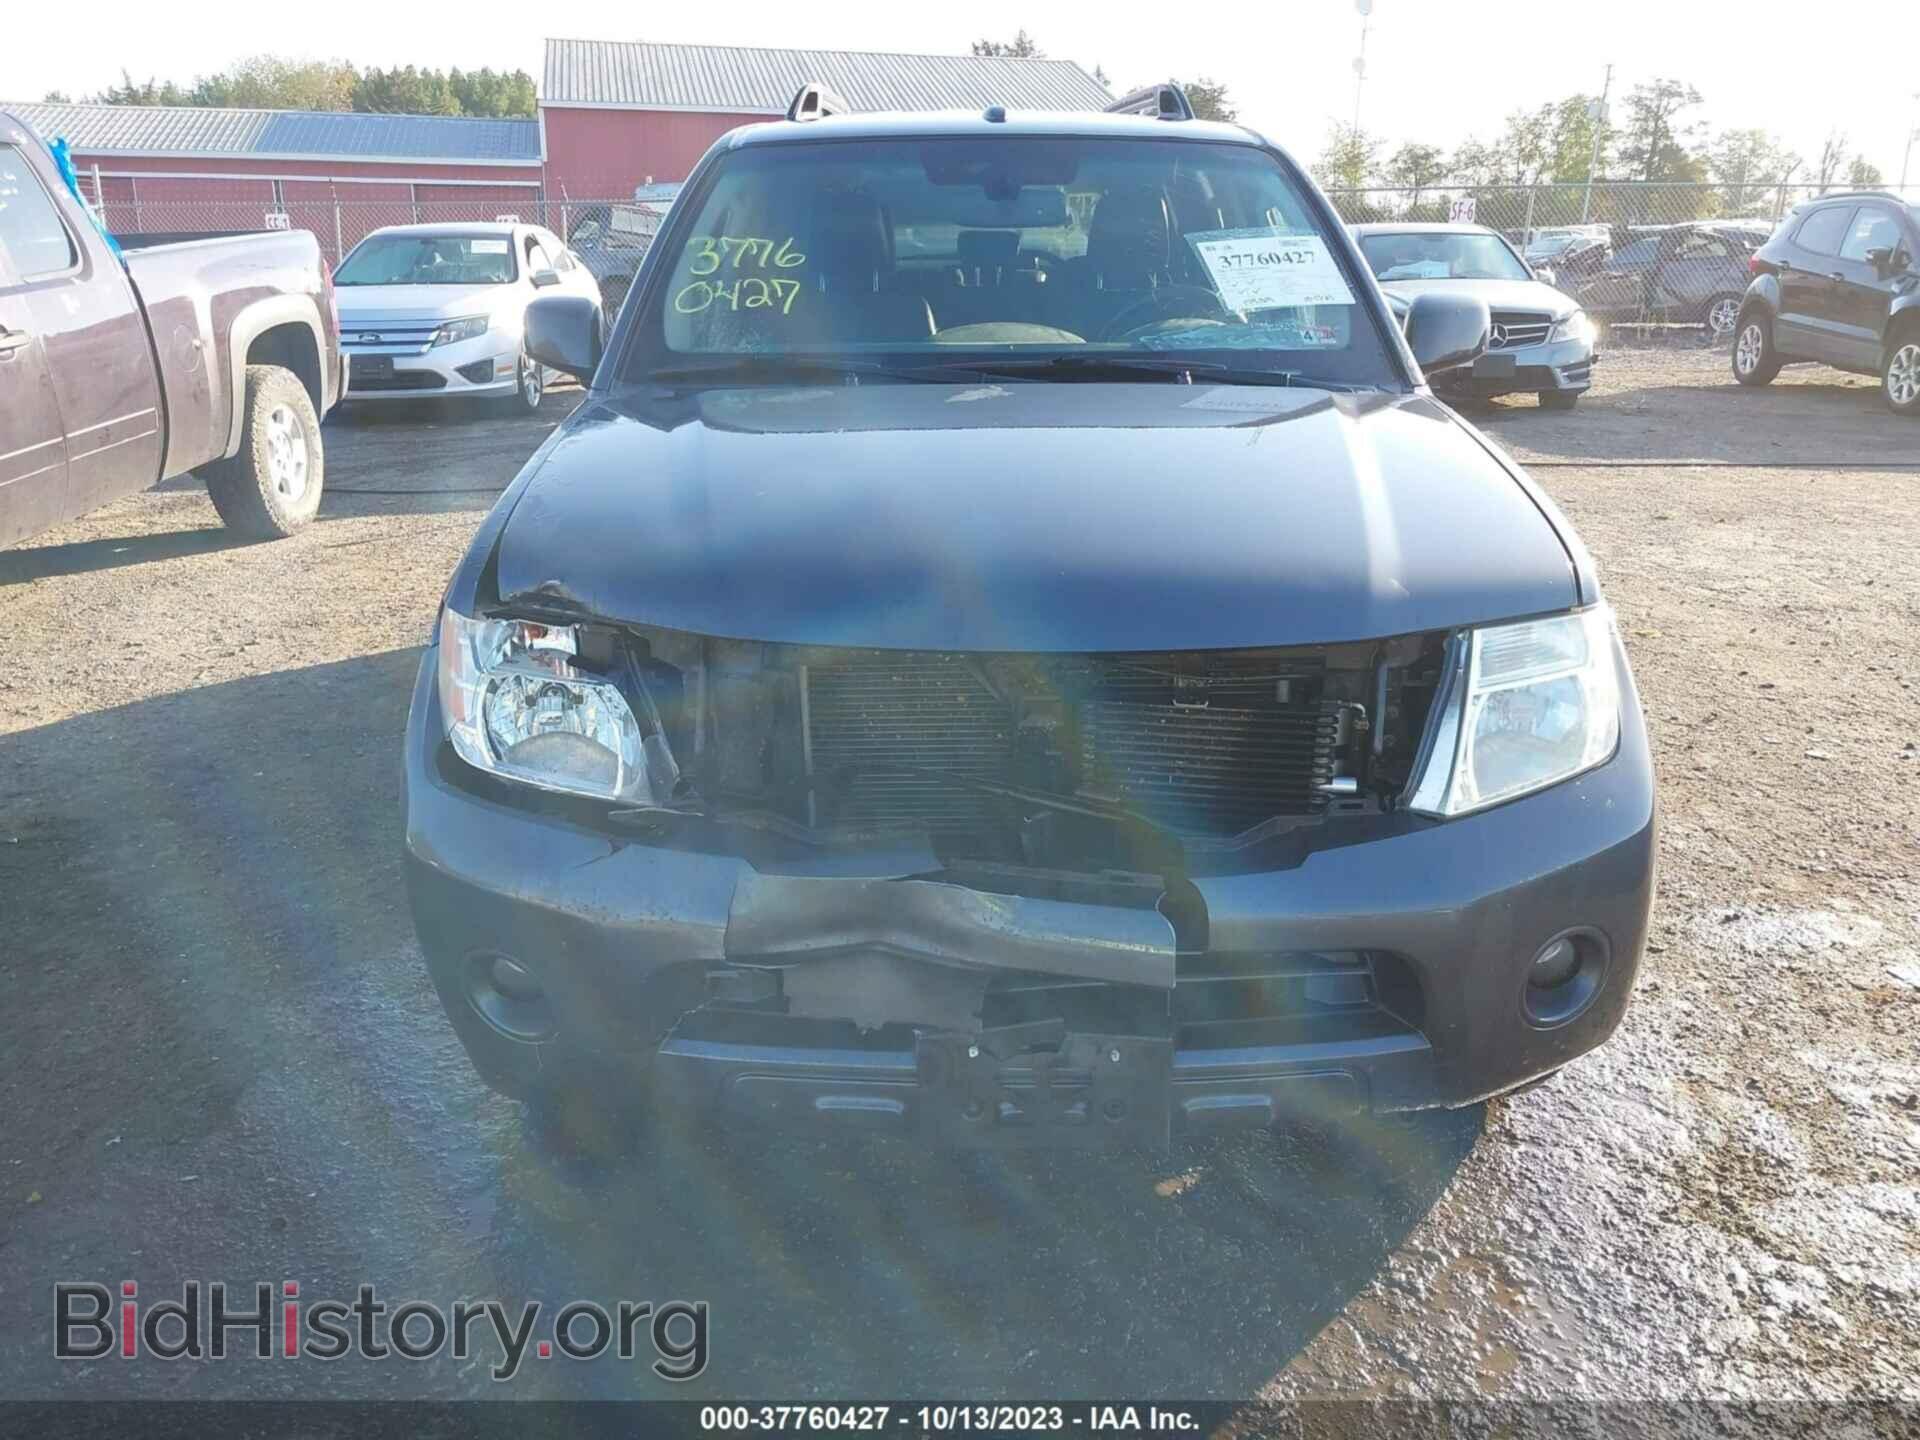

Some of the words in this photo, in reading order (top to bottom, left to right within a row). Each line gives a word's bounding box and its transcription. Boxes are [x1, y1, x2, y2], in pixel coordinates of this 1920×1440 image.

[1451, 201, 1474, 221] SF-6
[689, 236, 807, 275] 3776
[1218, 250, 1315, 269] 37760427
[674, 278, 801, 315] 0427
